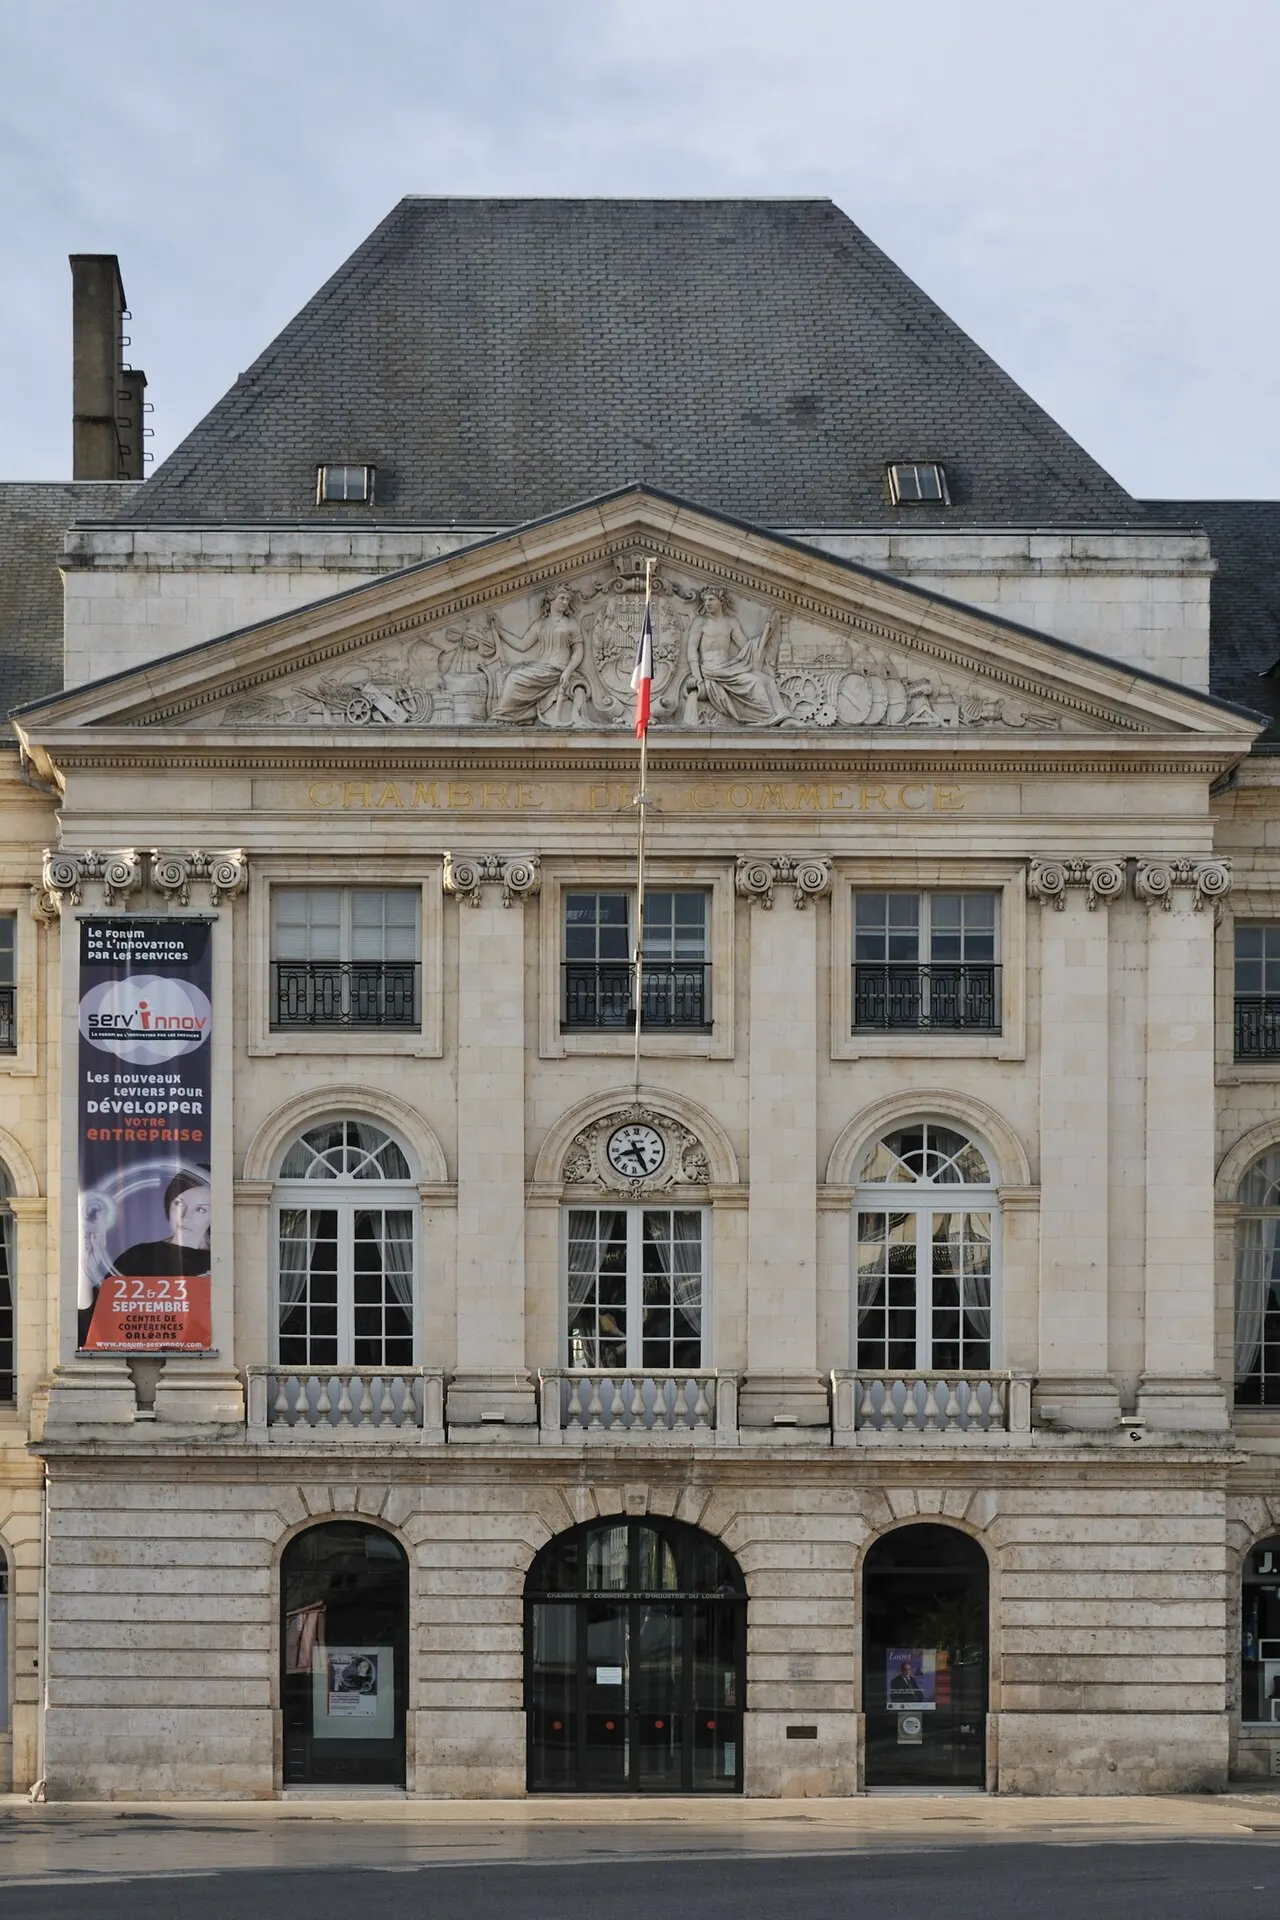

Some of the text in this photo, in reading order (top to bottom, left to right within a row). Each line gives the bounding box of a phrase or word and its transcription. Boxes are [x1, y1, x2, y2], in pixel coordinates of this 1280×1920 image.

[308, 782, 965, 811] CHAMBRE DE COMMERCE
[88, 928, 103, 938] Le
[87, 1071, 181, 1084] Les nouveaux
[112, 1301, 190, 1313] SEPTEMBRE
[126, 1314, 177, 1322] CENTRE DE
[1258, 1552, 1277, 1573] J.
